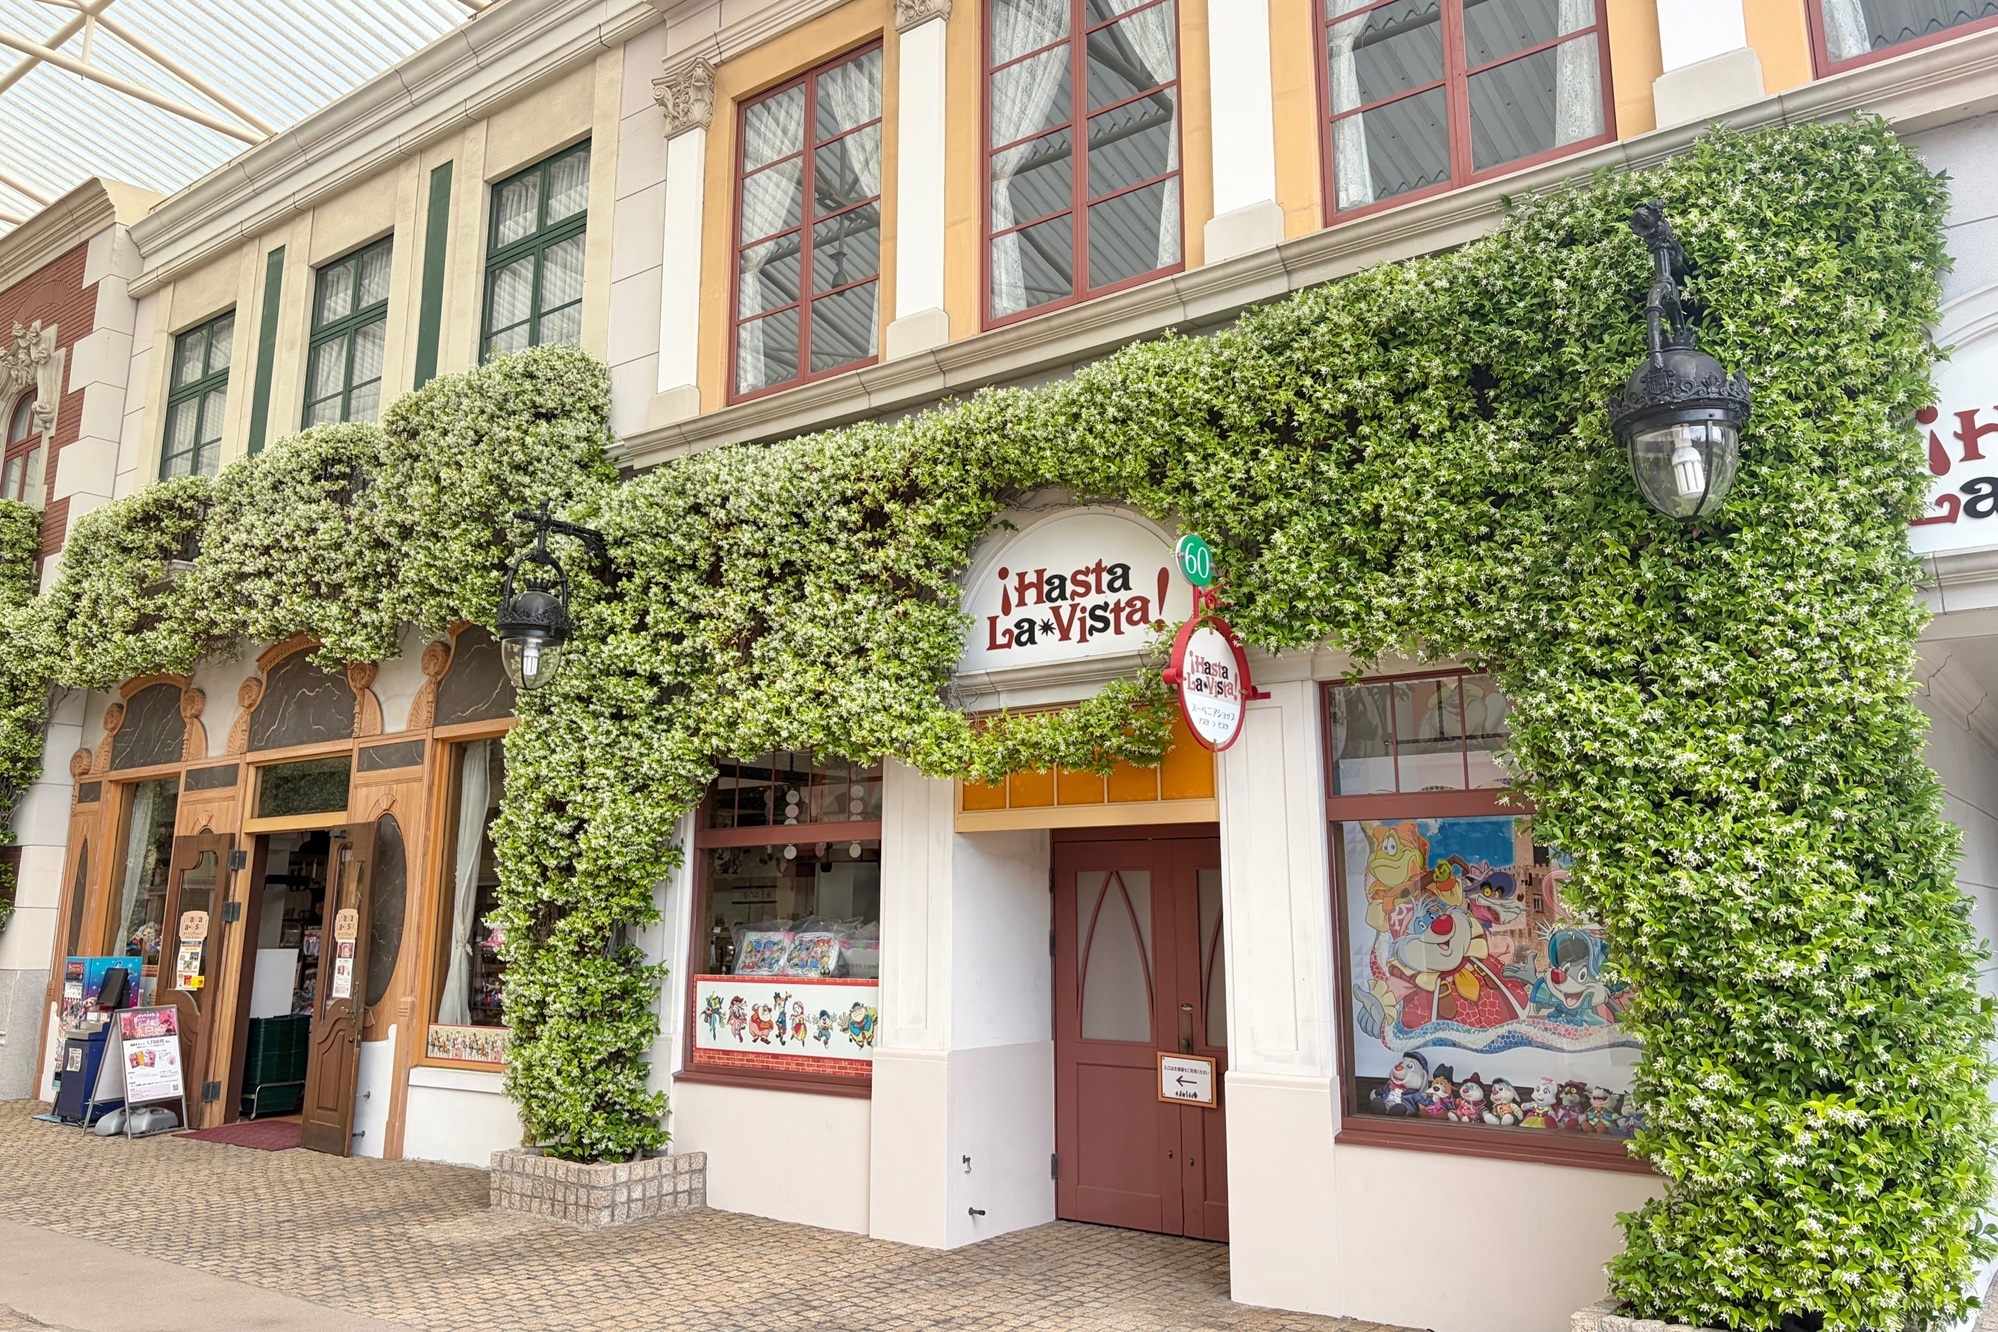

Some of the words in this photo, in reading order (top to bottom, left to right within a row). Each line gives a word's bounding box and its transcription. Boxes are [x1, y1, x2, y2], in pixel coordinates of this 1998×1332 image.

[1185, 542, 1210, 579] 60
[997, 558, 1132, 617] ¡Hasta
[1189, 650, 1229, 680] ¡Hasta
